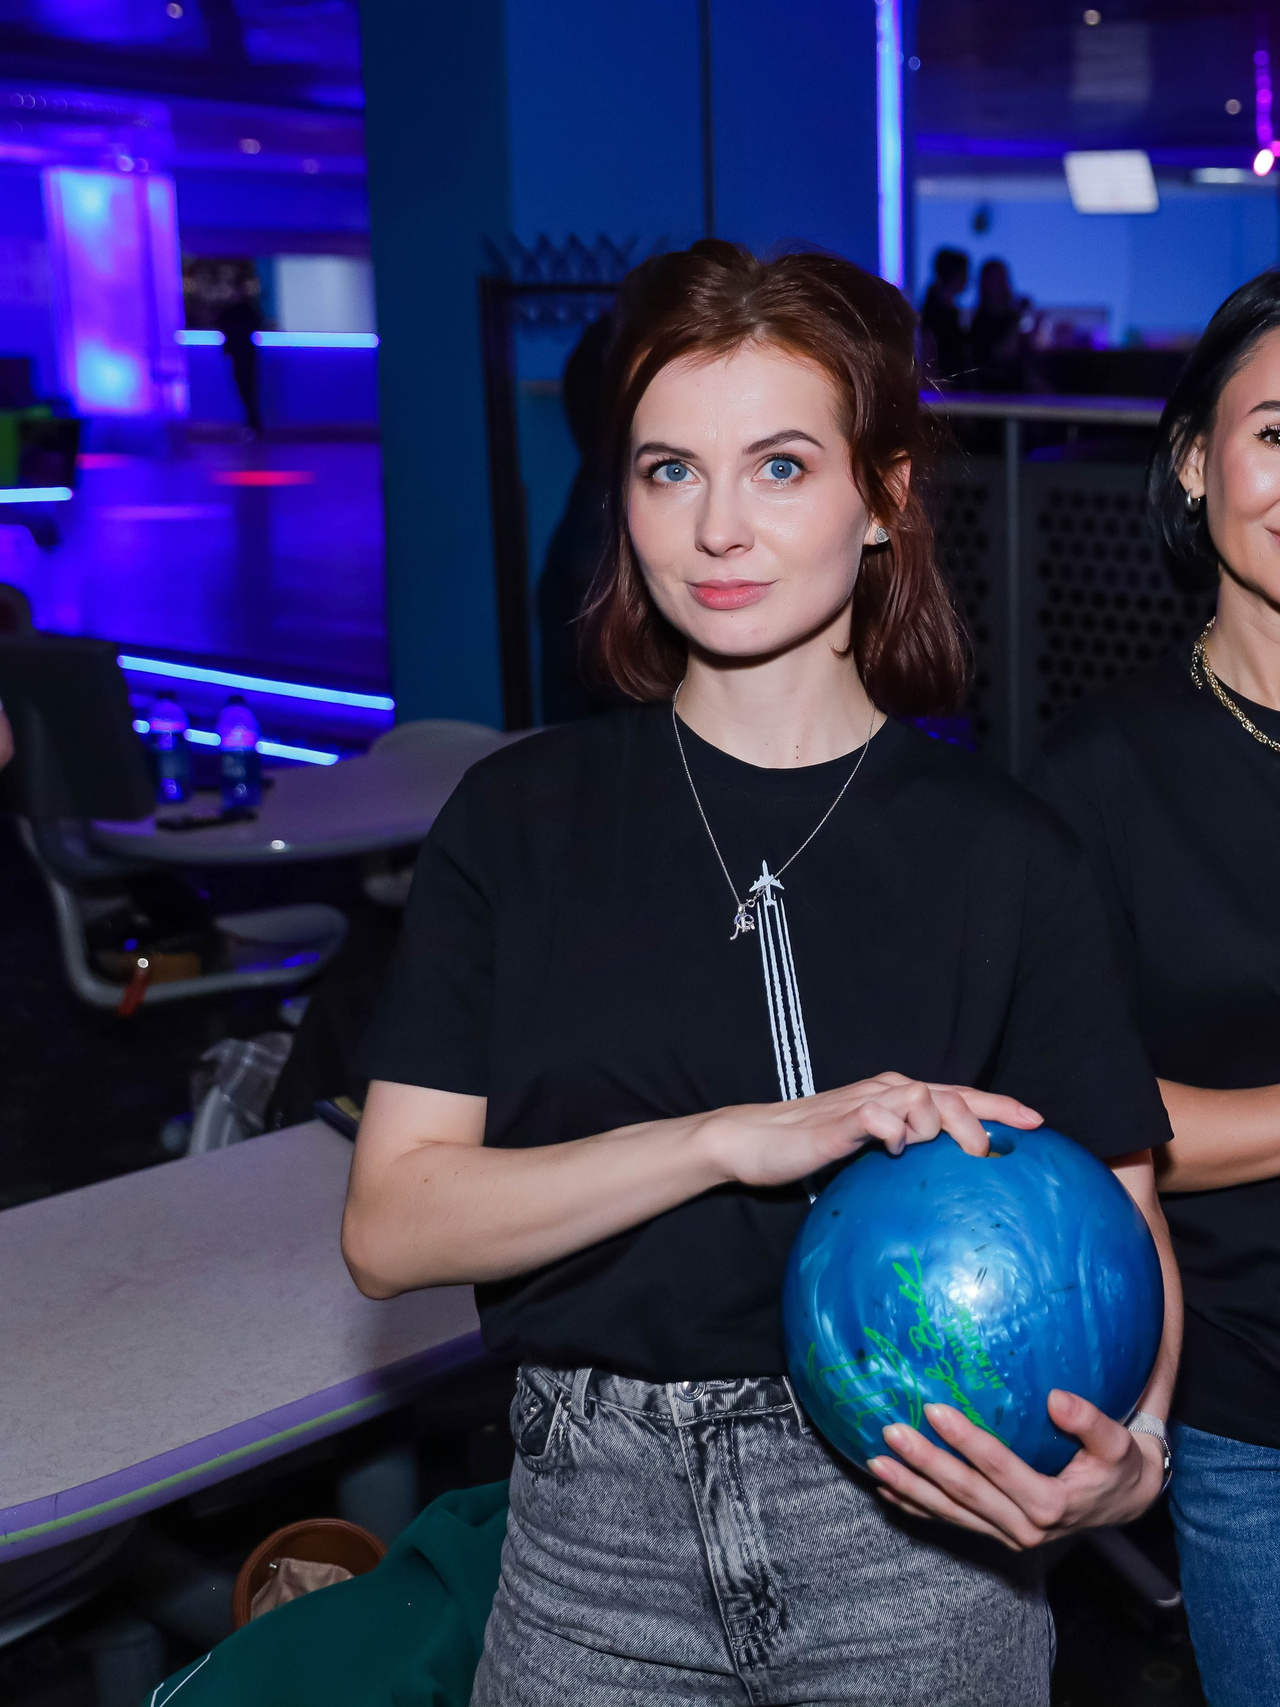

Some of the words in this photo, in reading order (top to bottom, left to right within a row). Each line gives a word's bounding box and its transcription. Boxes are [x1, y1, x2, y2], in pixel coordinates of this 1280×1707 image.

[893, 1247, 942, 1353] Ball
[820, 1354, 899, 1429] 11
[924, 1356, 1010, 1447] mart
